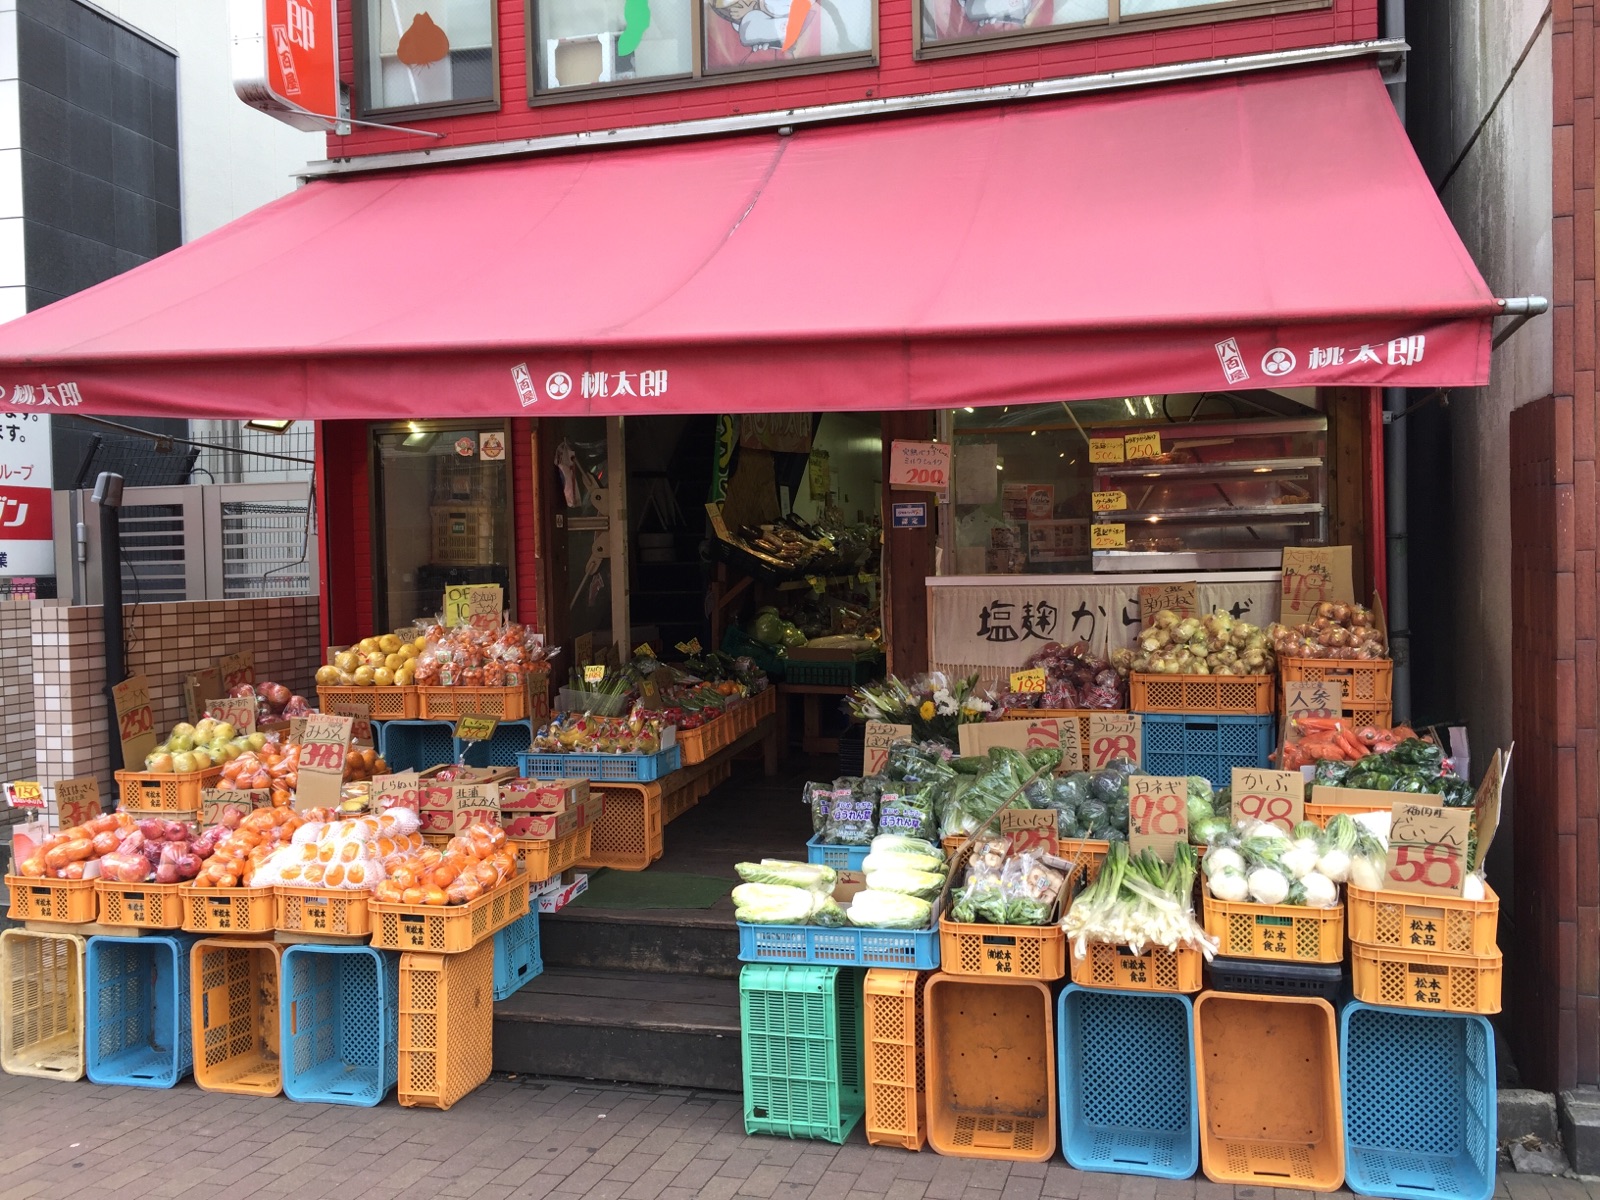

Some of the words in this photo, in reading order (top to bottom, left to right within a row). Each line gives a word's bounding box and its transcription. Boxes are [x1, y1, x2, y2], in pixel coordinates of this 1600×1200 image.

[1308, 335, 1426, 370] 桃太郎
[581, 370, 668, 398] 桃太郎
[10, 382, 83, 406] 桃太郎
[906, 468, 944, 483] 200
[1017, 677, 1046, 693] 198
[1291, 689, 1331, 710] 人参
[121, 706, 153, 740] 250
[306, 725, 345, 741] みかん
[1093, 735, 1136, 767] 98
[381, 780, 417, 791] しらぬい
[1136, 780, 1182, 795] 白ネギ
[1242, 773, 1292, 792] かぶ
[834, 810, 872, 821] ほうれん草
[1001, 812, 1055, 828] 生しいたけ
[1240, 794, 1294, 832] 98
[880, 815, 920, 828] ほうれん草
[1390, 816, 1464, 845] だいこん
[1389, 844, 1461, 888] 58
[41, 907, 51, 916] 食品
[133, 912, 145, 922] 食品
[219, 918, 230, 928] 食品
[314, 918, 326, 928] 食品
[1410, 919, 1437, 932] 松本
[411, 935, 424, 946] 食品
[1263, 929, 1287, 940] 松本
[1409, 932, 1437, 946] 食品
[1262, 941, 1287, 953] 食品
[996, 961, 1012, 972] 食品
[1130, 971, 1146, 982] 食品
[1414, 977, 1442, 990] 松本
[1414, 990, 1441, 1004] 食品
